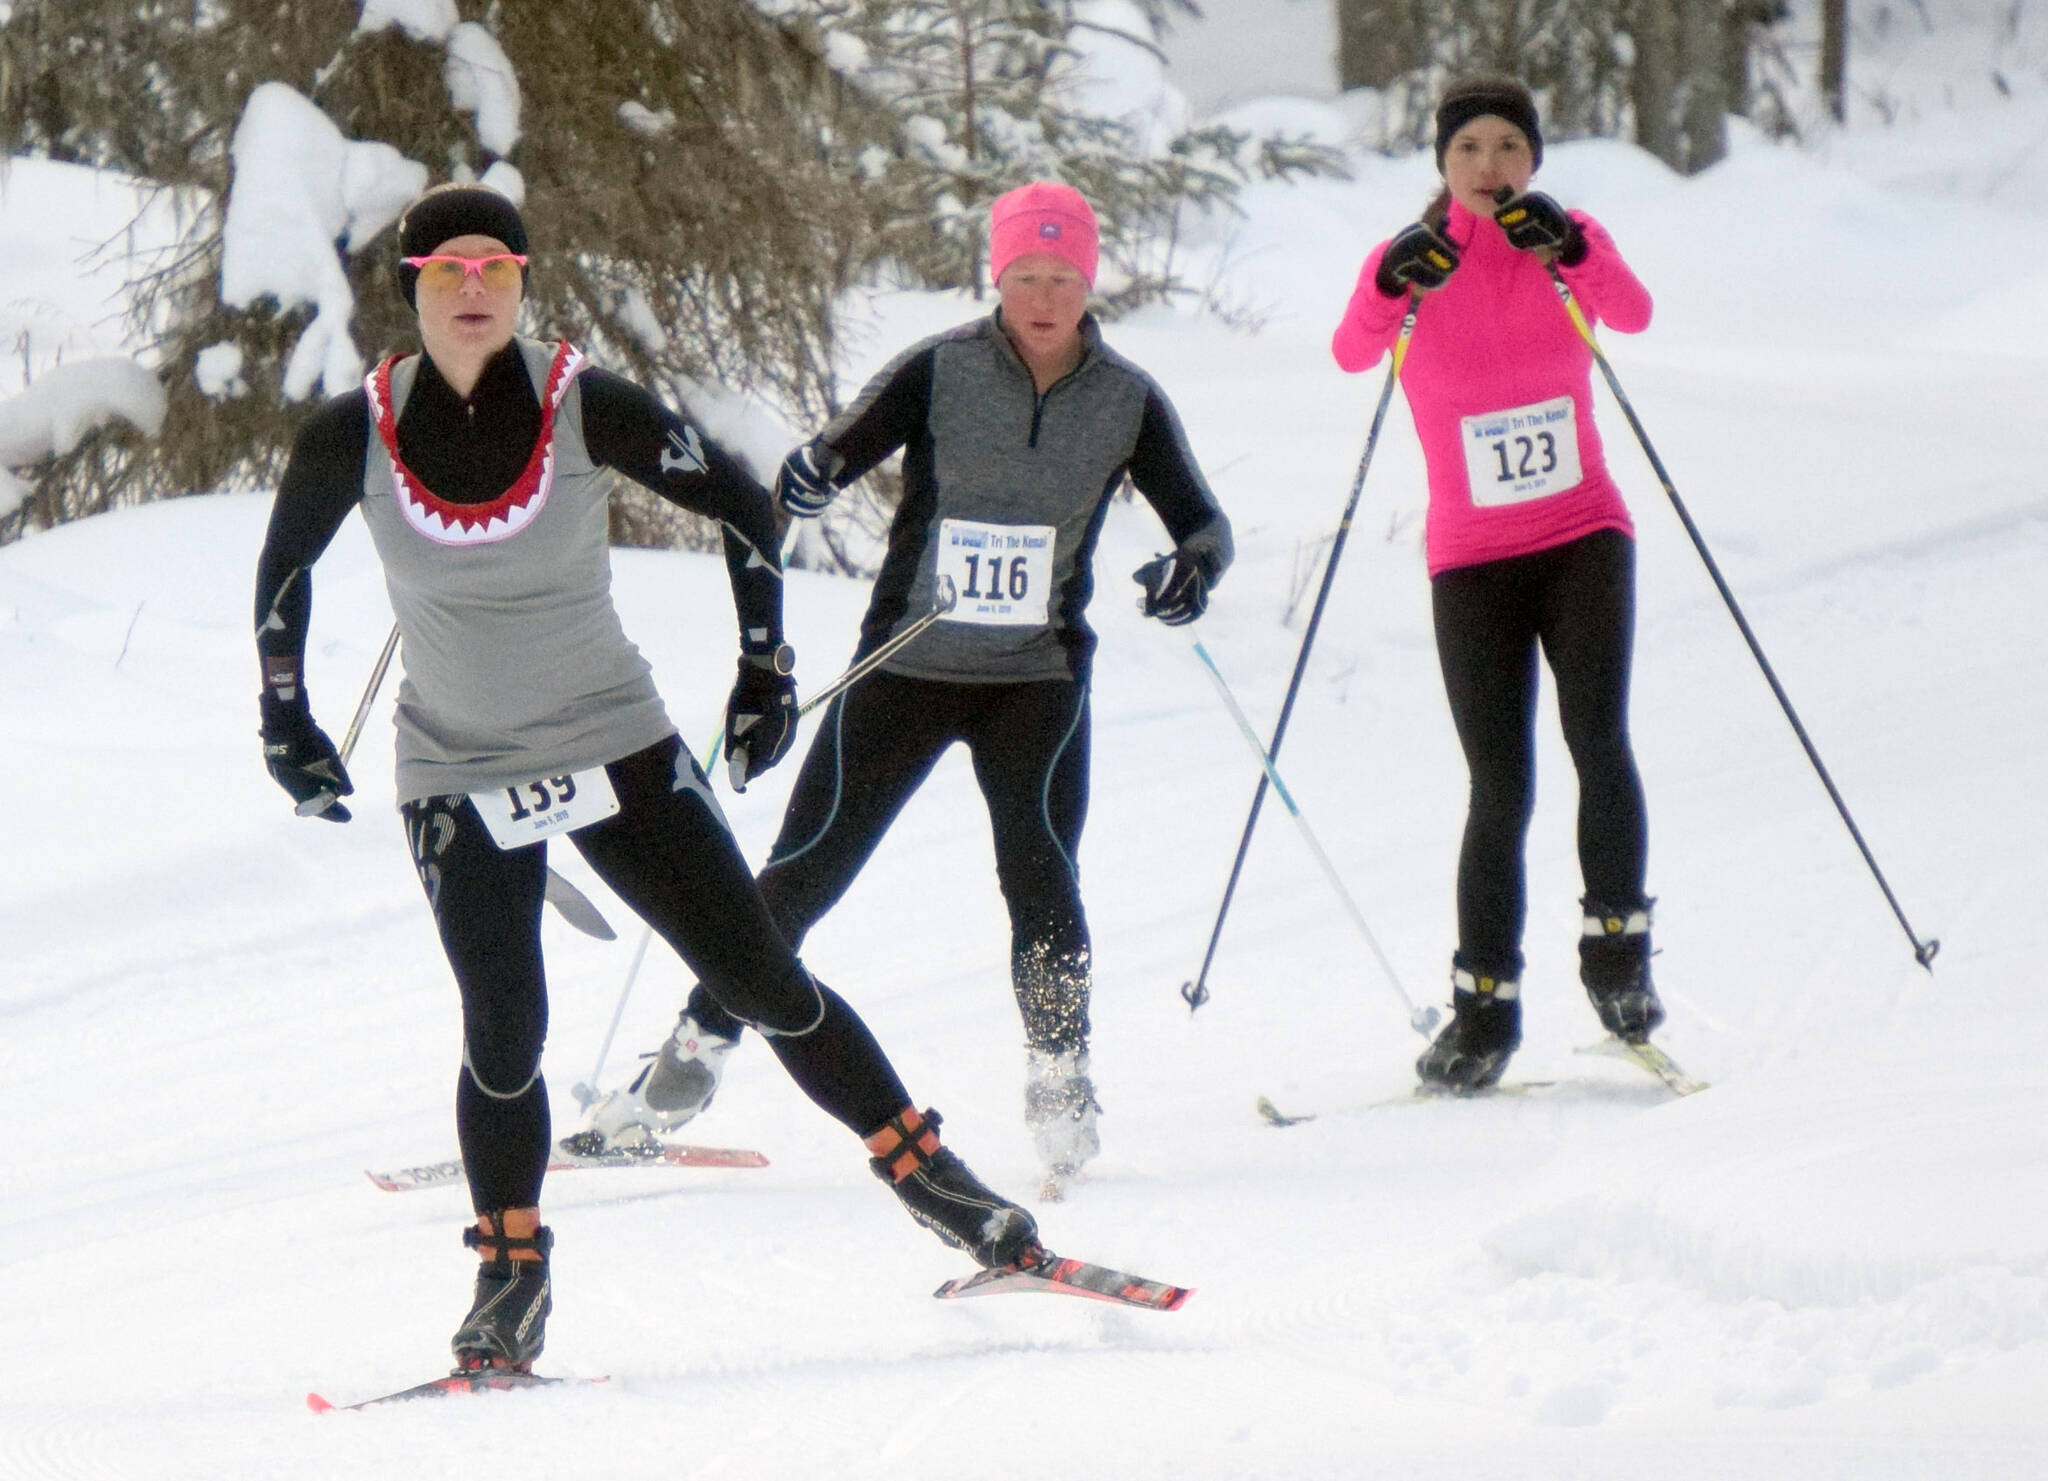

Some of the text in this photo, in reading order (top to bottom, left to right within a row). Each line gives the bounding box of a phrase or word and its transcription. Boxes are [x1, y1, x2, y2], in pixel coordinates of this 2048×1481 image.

[1492, 431, 1558, 482] 123
[991, 534, 1003, 549] Tri
[962, 553, 1028, 600] 116
[506, 774, 577, 822] 139
